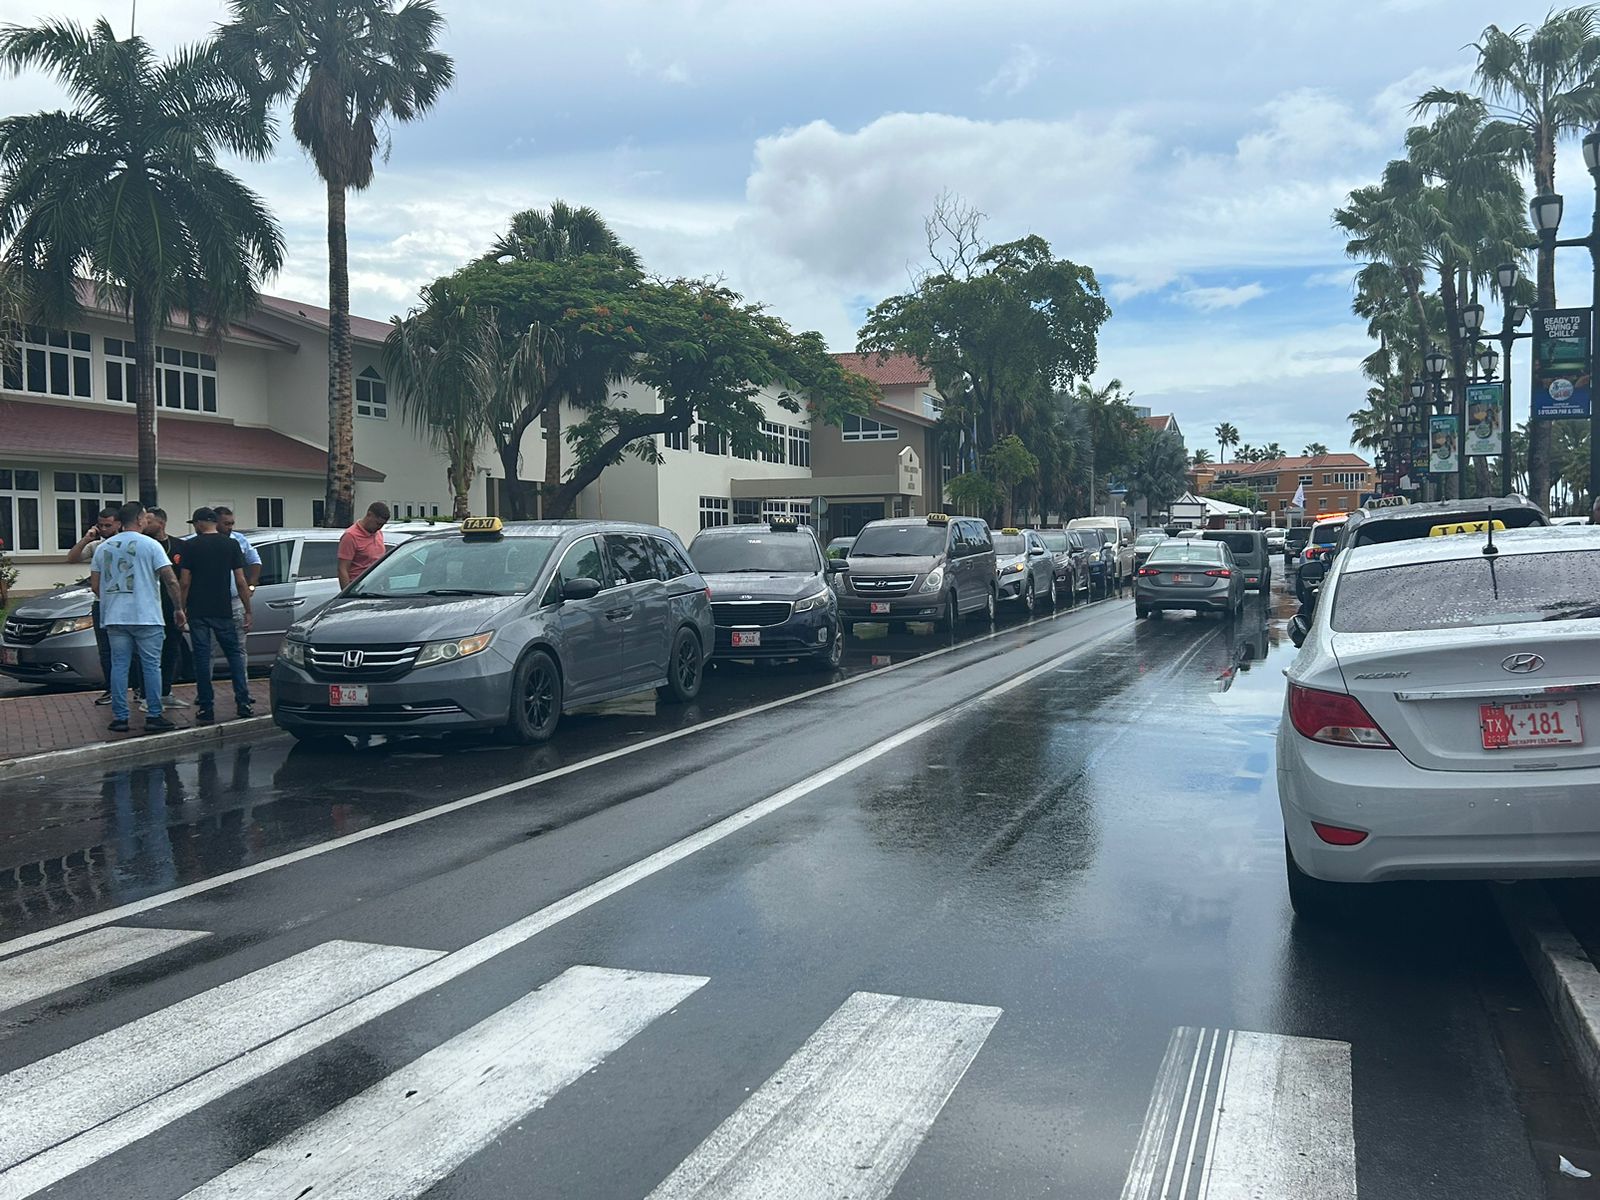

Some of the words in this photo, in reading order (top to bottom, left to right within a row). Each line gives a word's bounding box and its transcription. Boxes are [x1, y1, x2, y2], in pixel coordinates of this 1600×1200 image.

[1543, 317, 1568, 325] READY
[1545, 323, 1570, 331] SWING
[1549, 330, 1575, 338] CHILL?
[1374, 497, 1399, 508] TAXI
[467, 519, 493, 529] TAXI
[1354, 671, 1411, 680] ACCENT
[1486, 719, 1503, 733] TX
